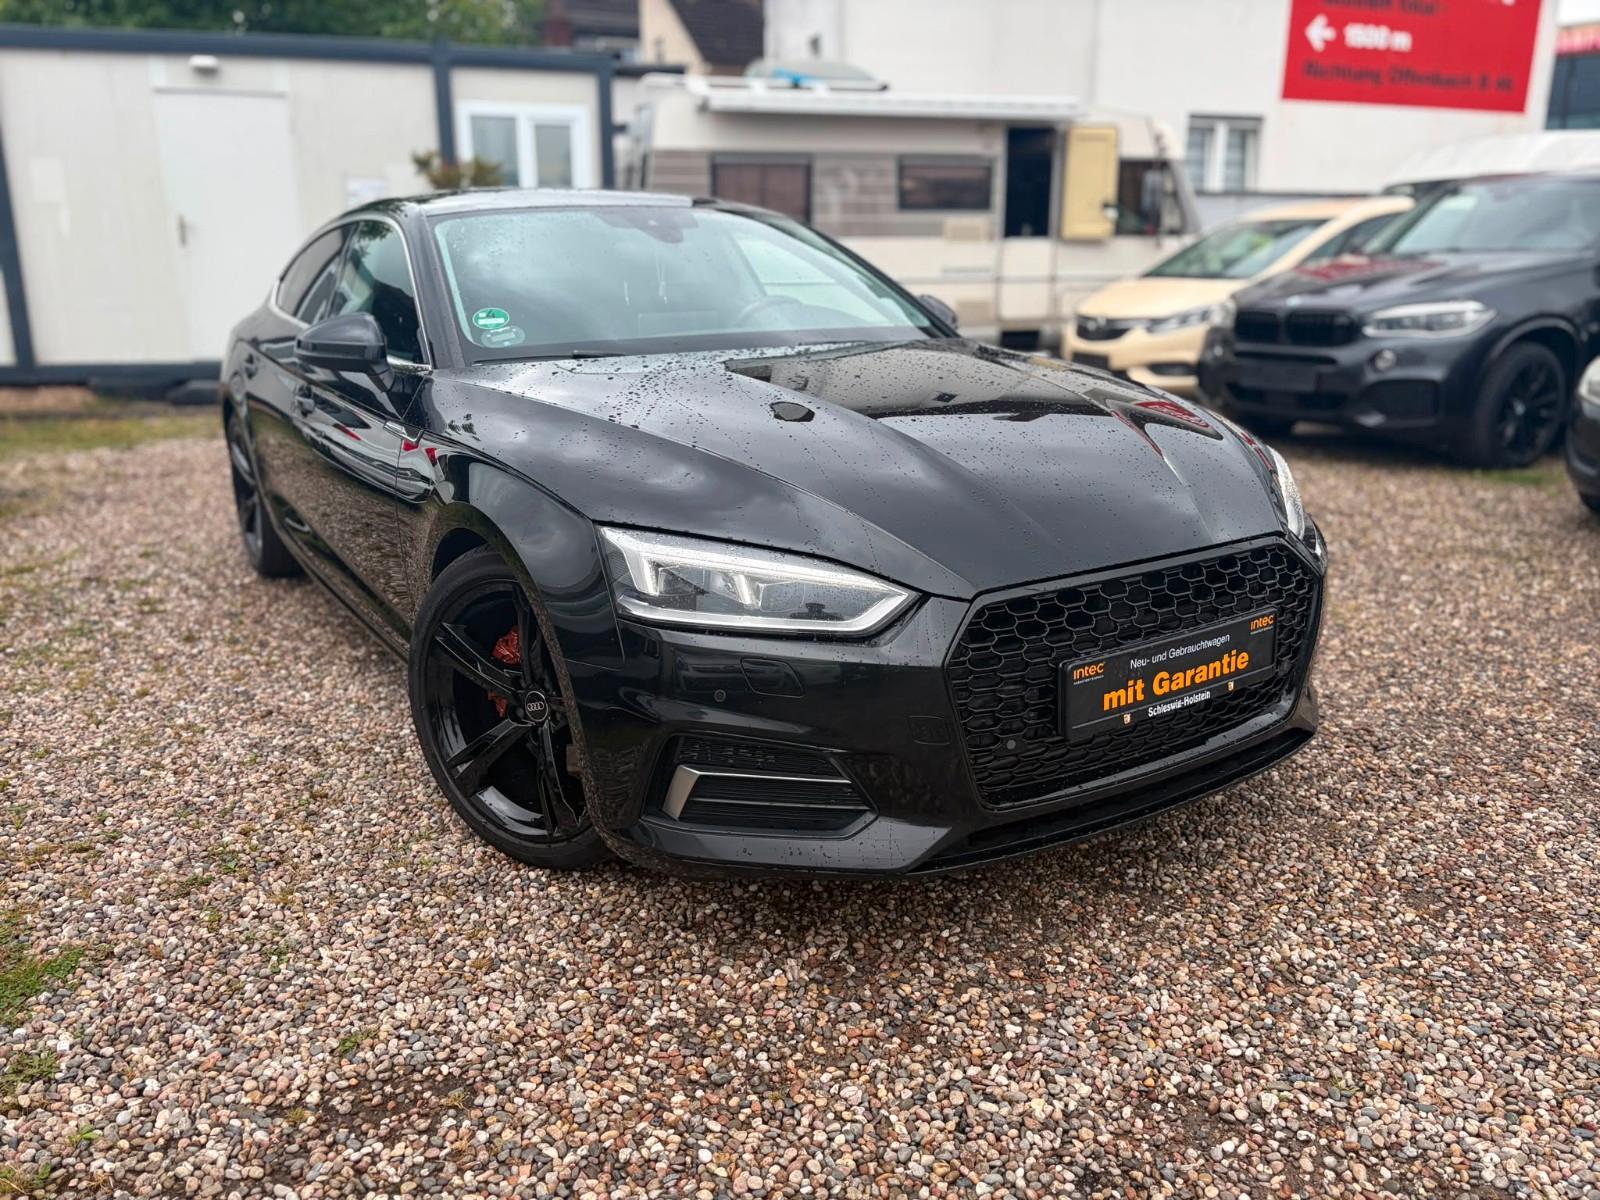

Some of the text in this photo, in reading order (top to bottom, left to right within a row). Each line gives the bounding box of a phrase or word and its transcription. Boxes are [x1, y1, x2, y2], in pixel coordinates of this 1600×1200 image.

[1304, 60, 1382, 85] Richtung
[1130, 633, 1230, 670] Neu- und Gebrauchtwagen
[1103, 649, 1249, 711] mit Garantie
